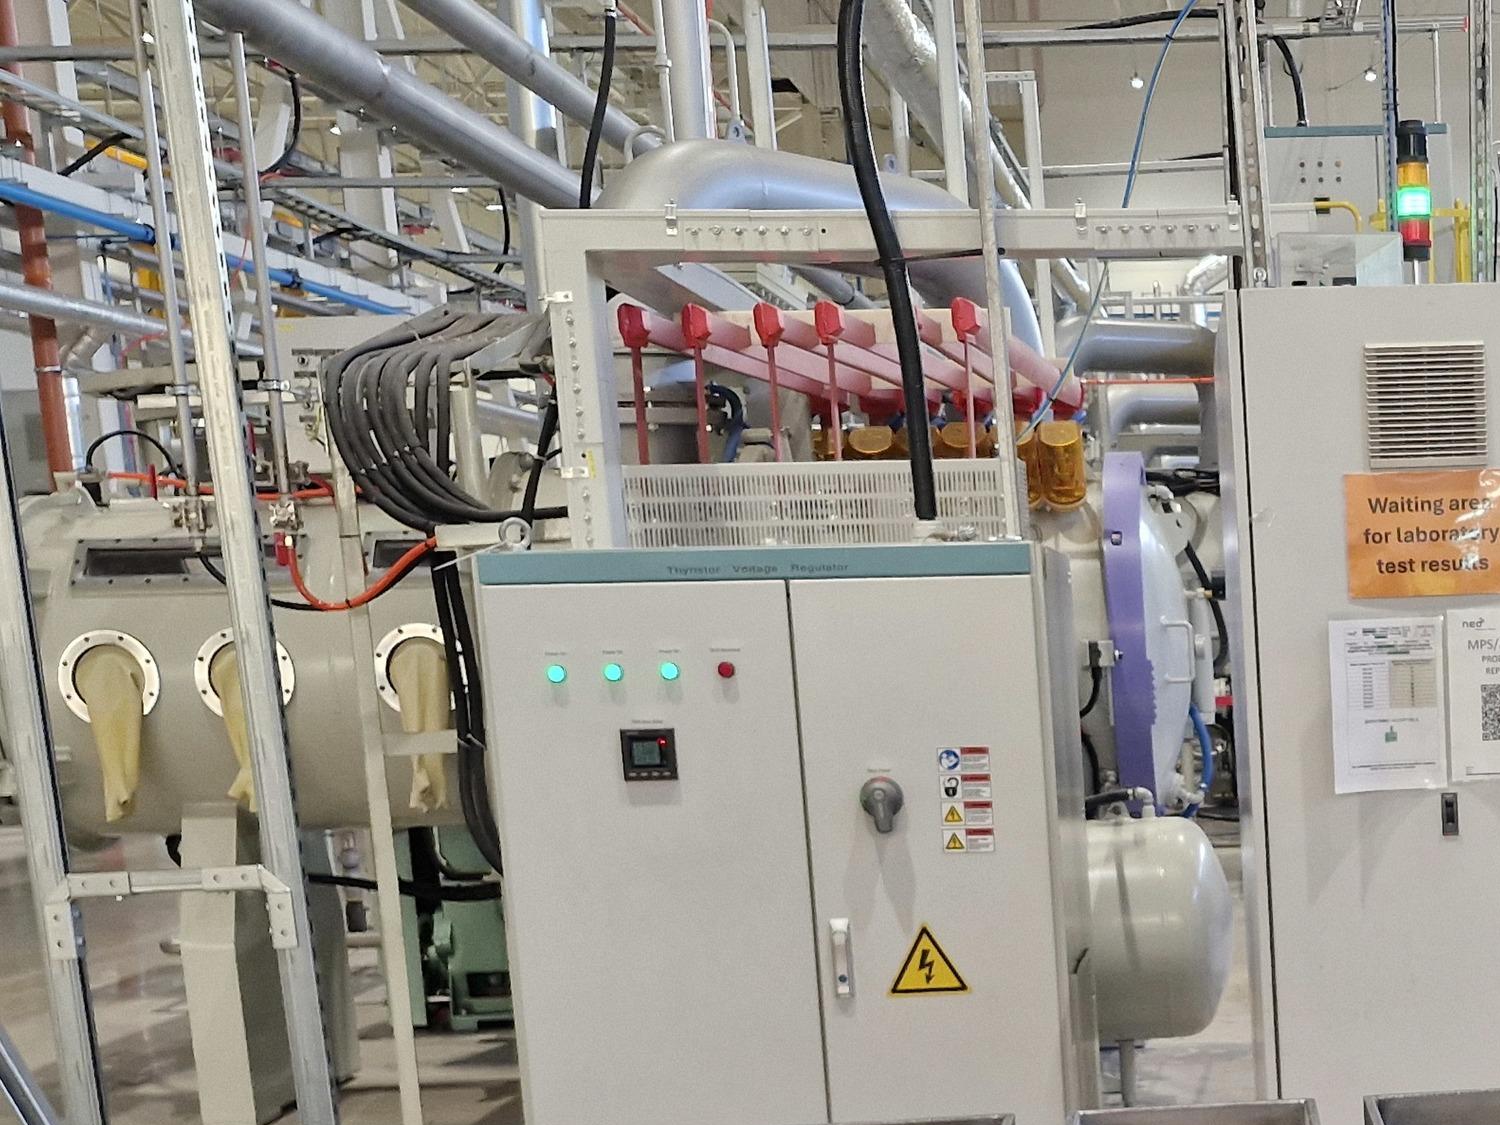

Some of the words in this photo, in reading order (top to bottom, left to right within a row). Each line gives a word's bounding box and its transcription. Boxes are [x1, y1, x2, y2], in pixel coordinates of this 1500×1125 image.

[1367, 496, 1445, 516] Waiting
[1363, 528, 1392, 544] for
[790, 563, 850, 573] Regulator
[1376, 558, 1416, 574] test
